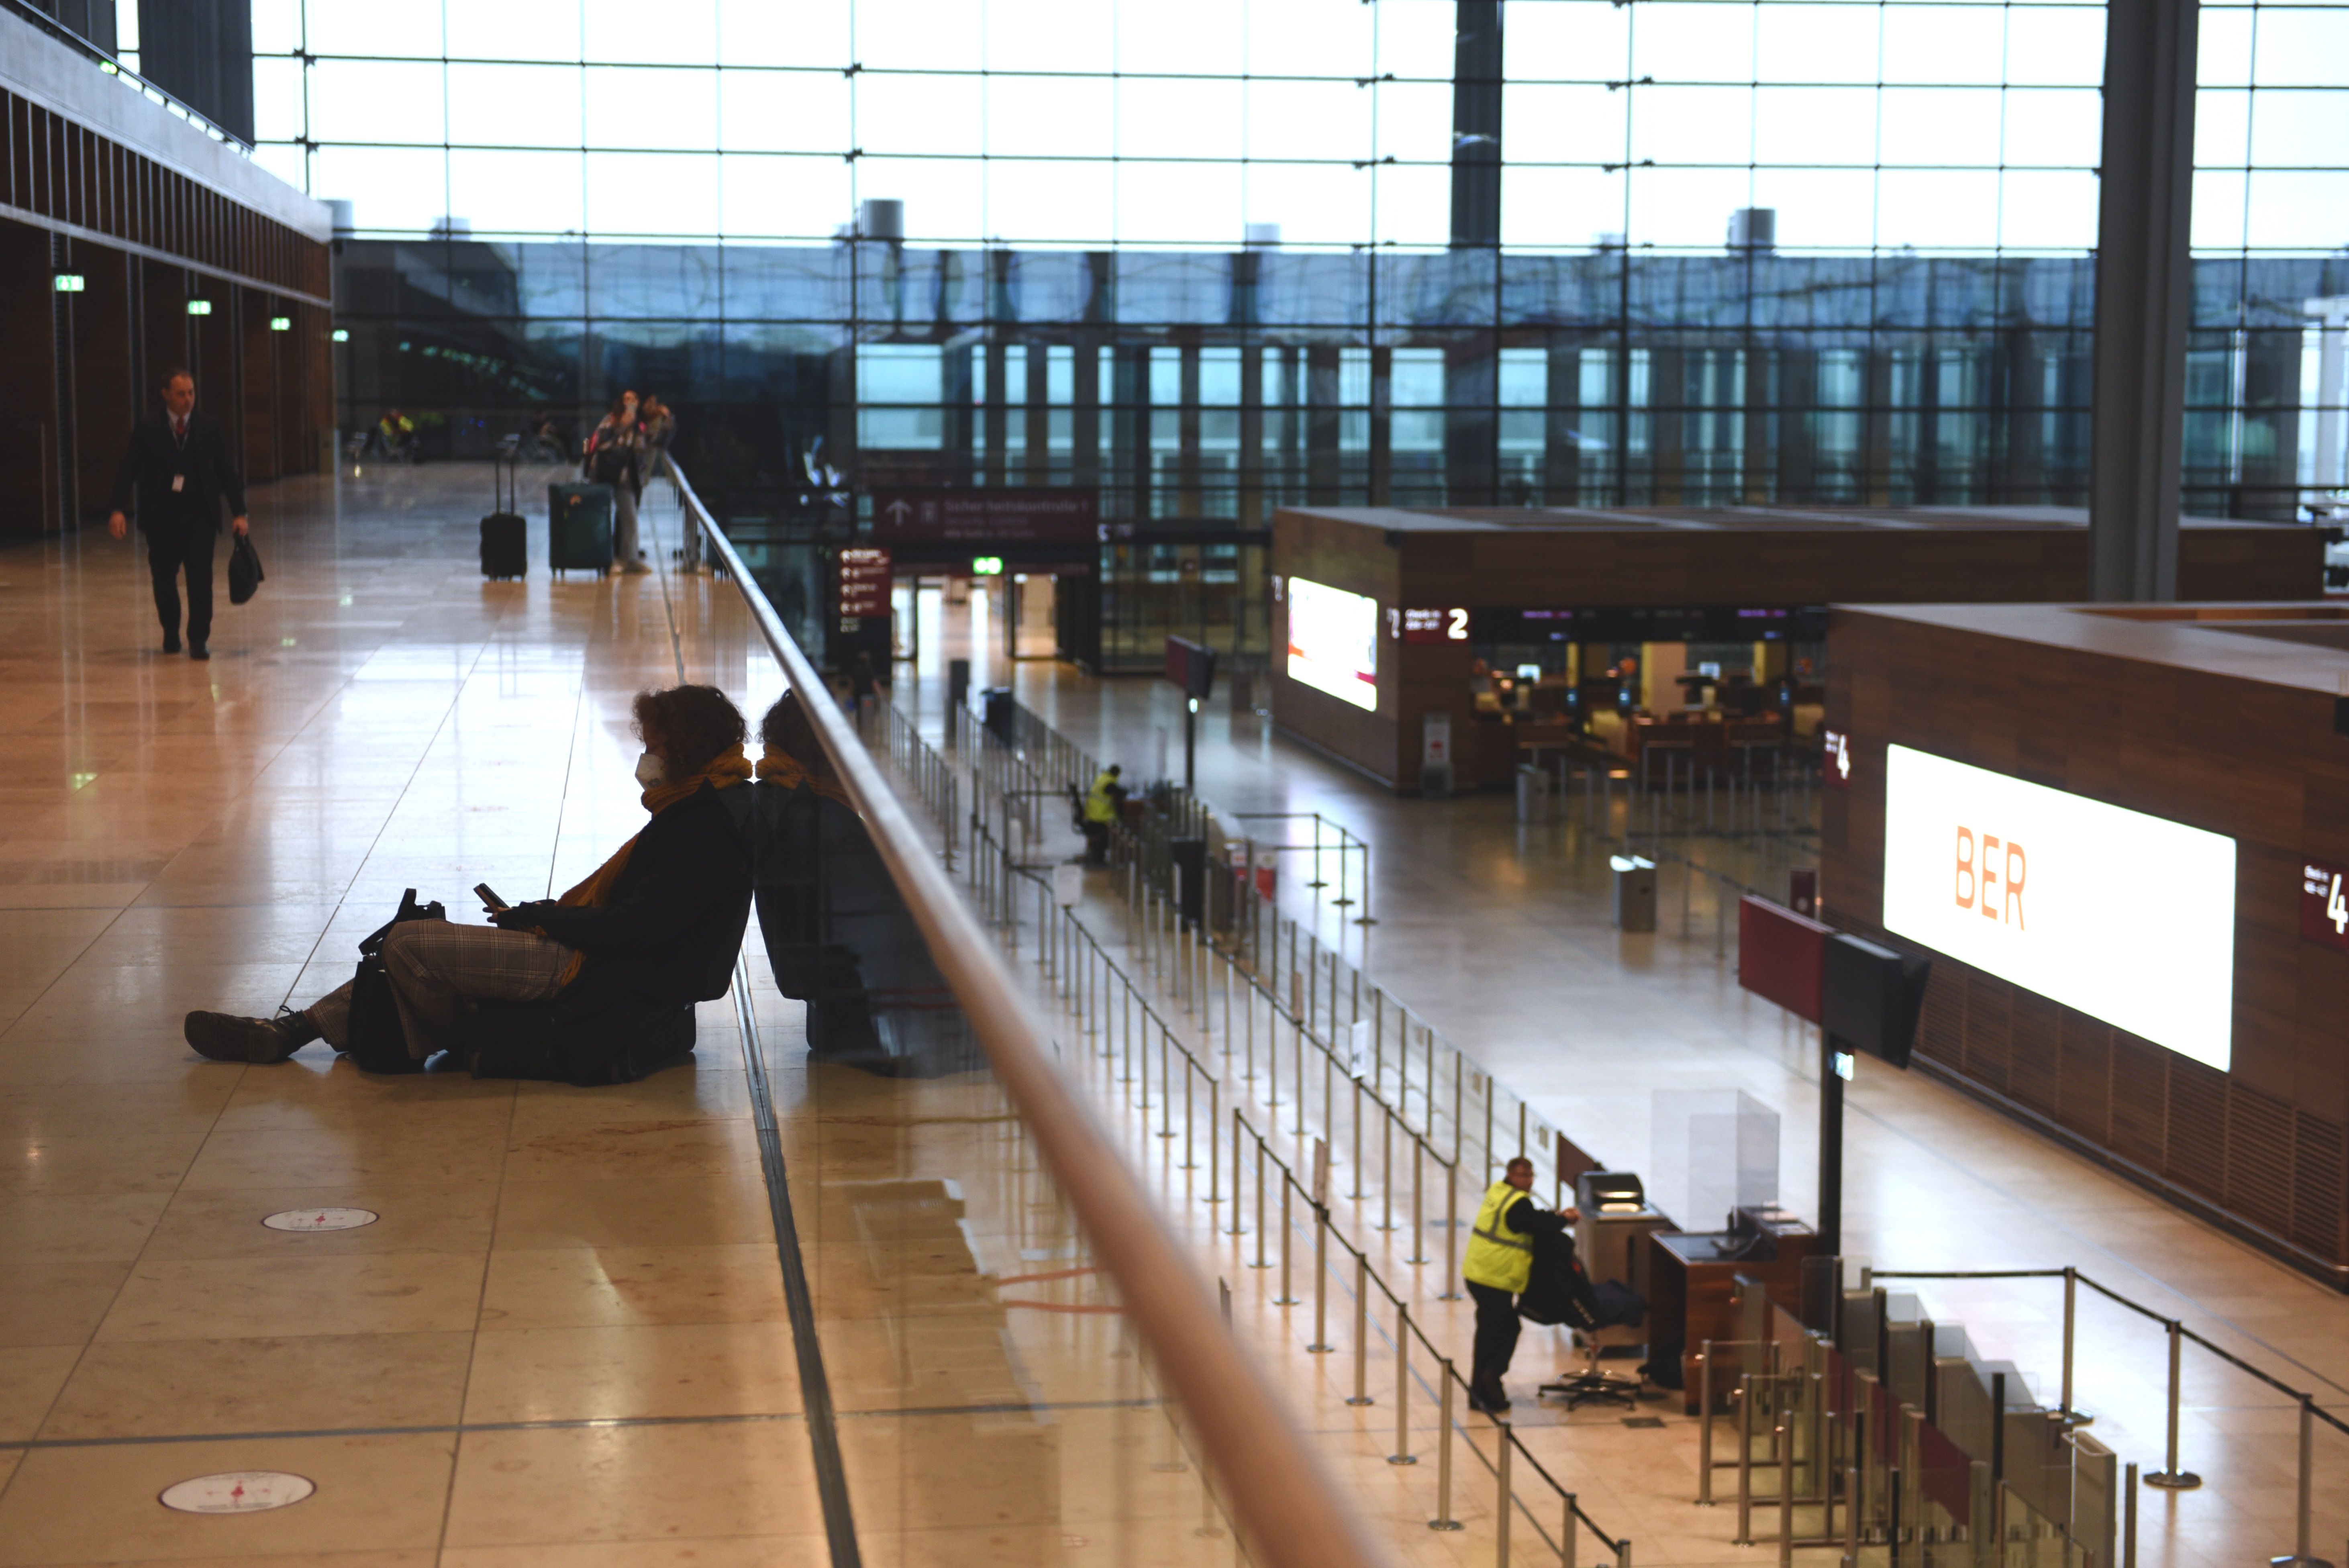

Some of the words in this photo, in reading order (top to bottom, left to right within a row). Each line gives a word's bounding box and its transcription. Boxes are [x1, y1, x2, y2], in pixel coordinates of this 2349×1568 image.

[1448, 608, 1468, 639] 2
[1956, 825, 2026, 931] BER
[2327, 874, 2349, 935] 4
